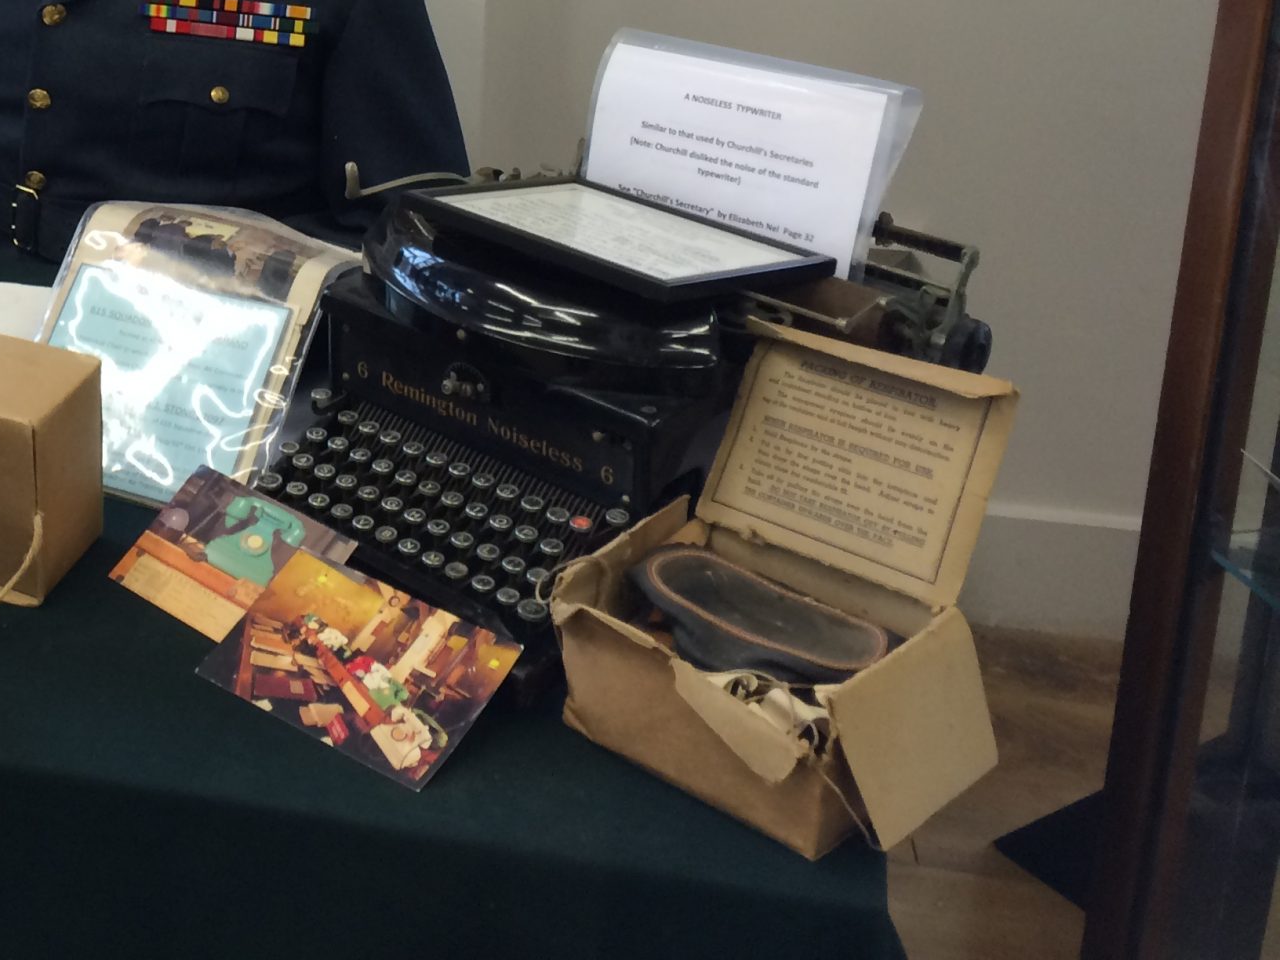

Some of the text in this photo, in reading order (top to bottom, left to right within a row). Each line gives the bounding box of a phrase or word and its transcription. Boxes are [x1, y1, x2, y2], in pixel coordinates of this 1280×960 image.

[692, 94, 732, 110] NOISELESS
[736, 104, 782, 120] TYPWRITER
[630, 136, 653, 148] (Note:
[655, 143, 688, 158] Churchill
[689, 152, 718, 164] disliked
[720, 158, 733, 168] the
[735, 163, 756, 173] noise
[768, 170, 781, 179] the
[783, 175, 819, 188] standard
[641, 121, 667, 133] Similar
[679, 129, 694, 139] that
[696, 134, 714, 144] used
[716, 137, 725, 148] by
[727, 140, 767, 156] Churchill's
[770, 150, 814, 167] Secretaries
[697, 167, 741, 185] typewriter)
[618, 184, 630, 193] See
[675, 199, 714, 215] Secretary"
[718, 210, 726, 221] by
[729, 213, 764, 229] Elizabeth
[766, 223, 779, 232] Nel
[784, 228, 802, 241] Page
[803, 233, 814, 242] 32
[357, 361, 368, 379] 6
[801, 360, 937, 408] PACKING OF RESPIRATOR
[382, 371, 583, 472] Remington Noiseless
[601, 465, 614, 485] 6
